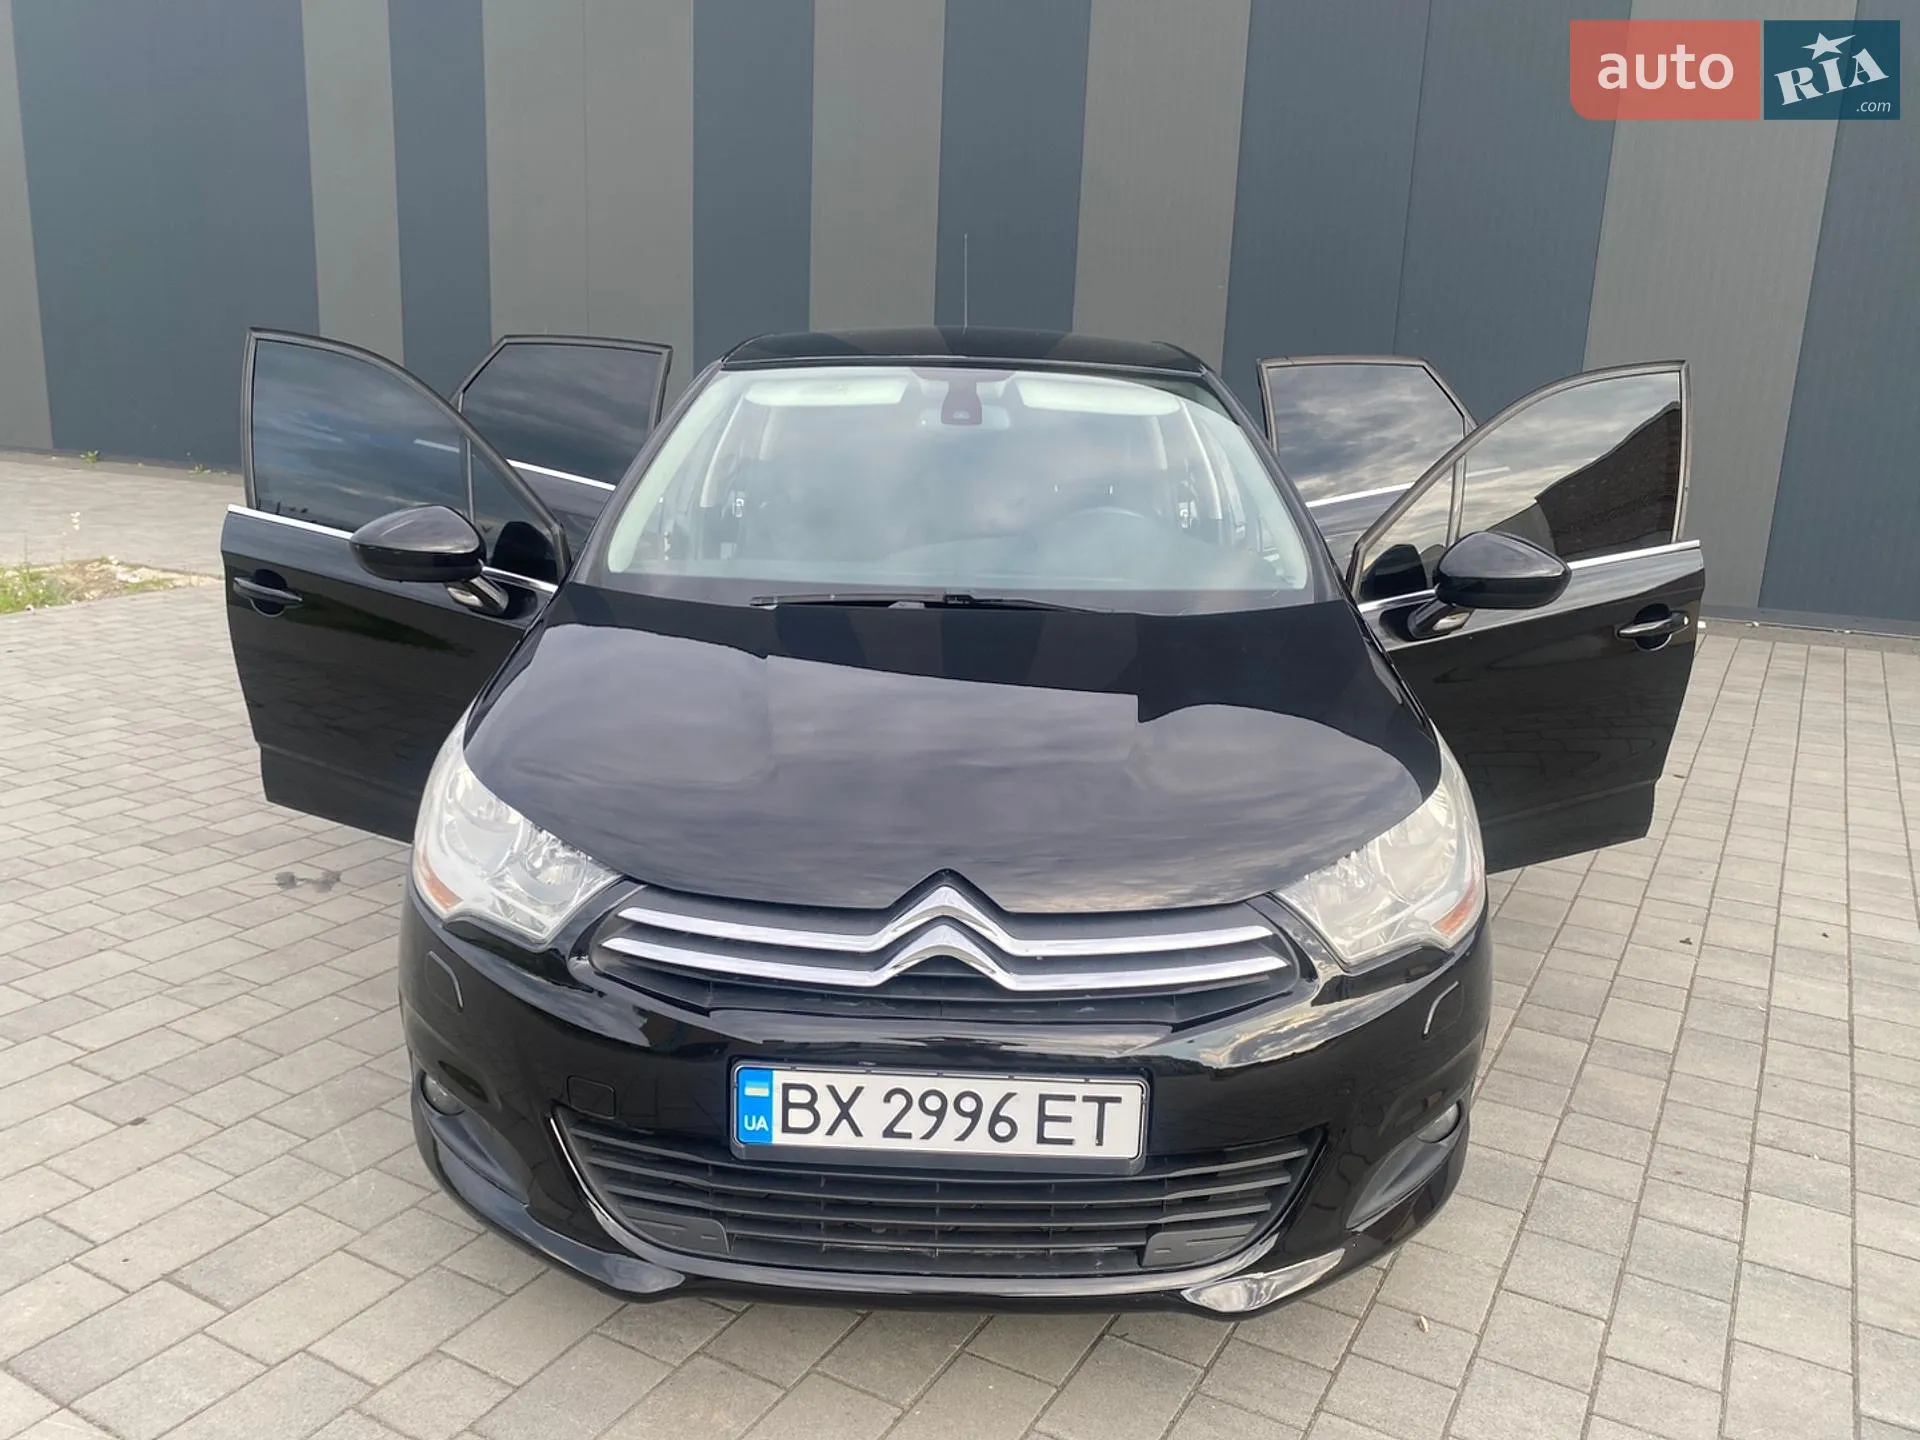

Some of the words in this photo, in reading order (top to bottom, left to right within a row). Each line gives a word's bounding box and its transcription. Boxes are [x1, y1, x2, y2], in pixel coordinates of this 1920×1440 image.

[743, 1114, 769, 1132] UA
[780, 1082, 865, 1138] BX
[882, 1087, 1019, 1144] 2996
[1036, 1093, 1122, 1147] ET
